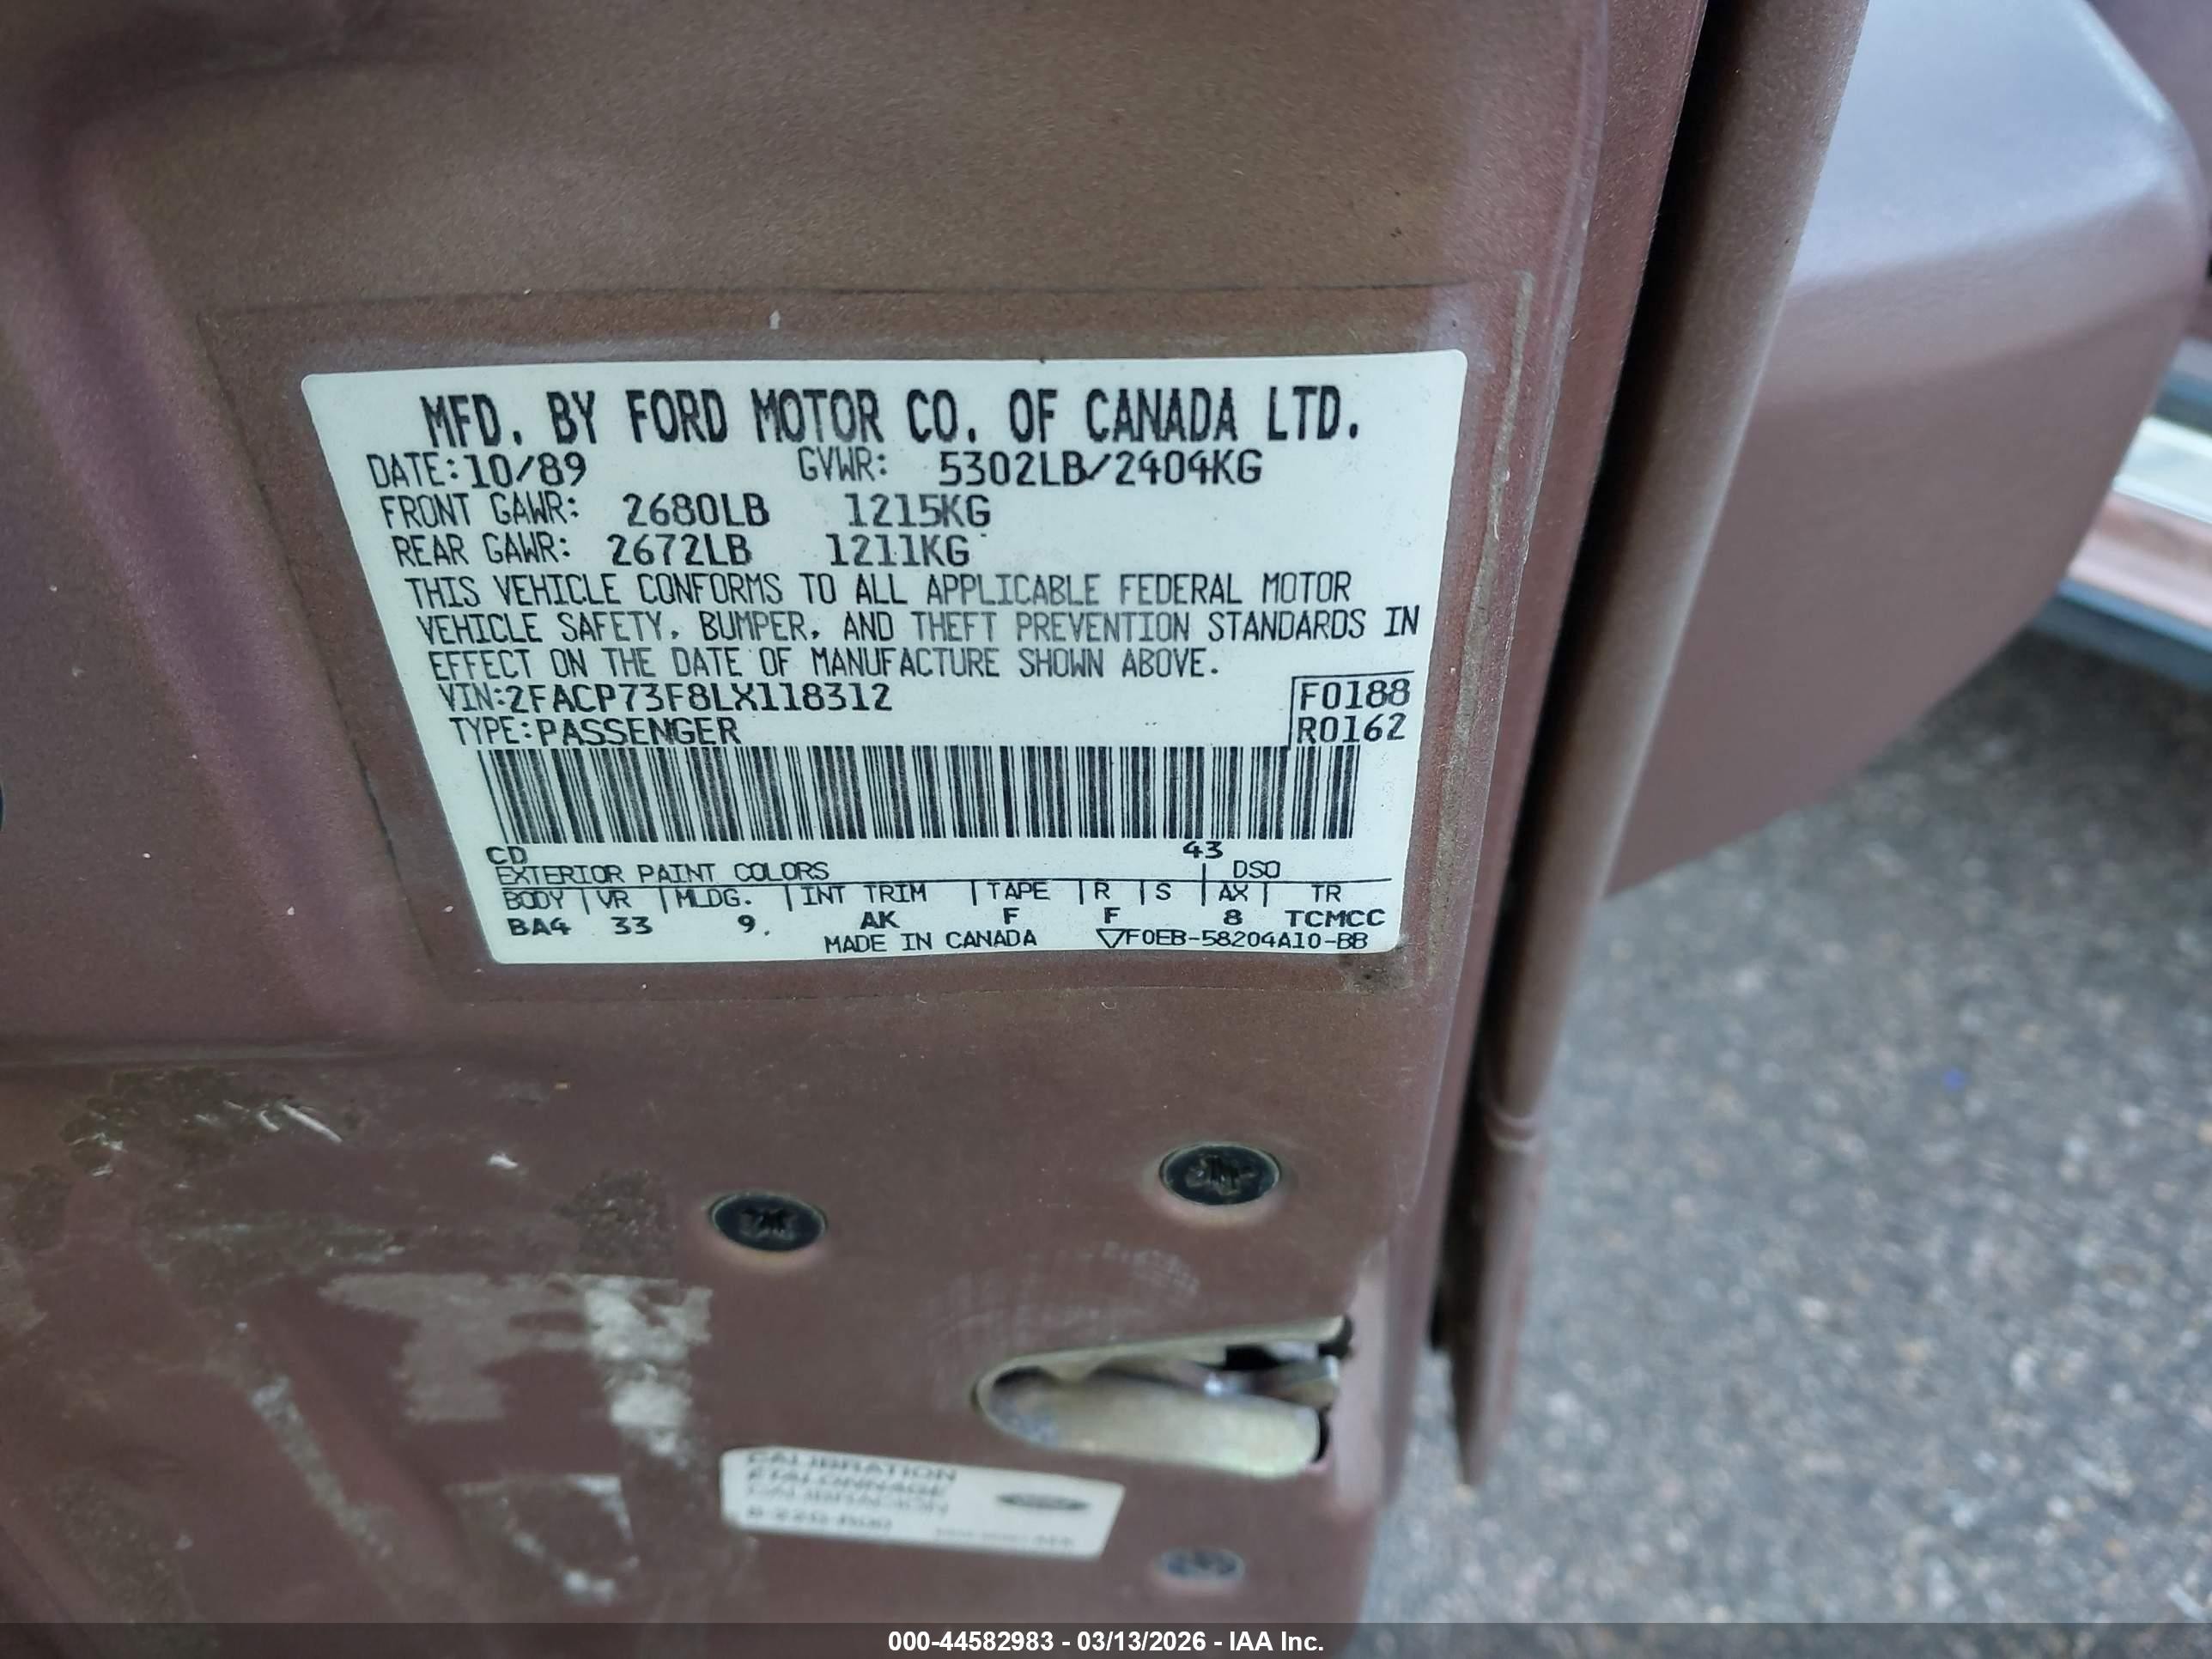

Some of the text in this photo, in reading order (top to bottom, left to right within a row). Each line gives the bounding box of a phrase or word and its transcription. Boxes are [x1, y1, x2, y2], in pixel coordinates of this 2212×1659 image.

[420, 386, 1358, 448] MFD. BY FORD MOTOR CO. OF CANADA LTD.
[798, 447, 887, 482] GVWR:
[939, 449, 1262, 487] 5302LB/2404KG
[380, 490, 991, 529] FRONT GAWR: 2680LB 1215KG
[392, 532, 969, 568] REAR GAWR: 2672LB 1211KG
[405, 571, 1352, 609] THIS VEHICLE CONFORMS TO ALL APPLICABLE FEDERAL MOTOR
[416, 613, 543, 646] VEHICLE
[845, 611, 894, 641] AND
[911, 611, 997, 642] THEFT
[1017, 612, 1189, 642] PREVENTION
[1209, 609, 1366, 641] STANDARDS
[1384, 605, 1419, 637] IN
[428, 647, 1218, 681] EFFECT ON THE DATE OF MANUFACTURE SHOWN ABOVE.
[486, 847, 528, 865] CD
[1183, 842, 1223, 859] 43
[495, 862, 830, 885] EXTERIOR PAINT COLORS
[502, 880, 1346, 910] BODY VR MLDG. INT TRIM TAPE R S AX TR
[611, 917, 653, 934] 33
[860, 911, 900, 930] AK
[1004, 908, 1020, 925] F
[1105, 908, 1121, 924] F
[1224, 909, 1243, 926] 8
[1285, 909, 1386, 927] TCMCC
[825, 930, 1037, 954] MADE IN CANADA
